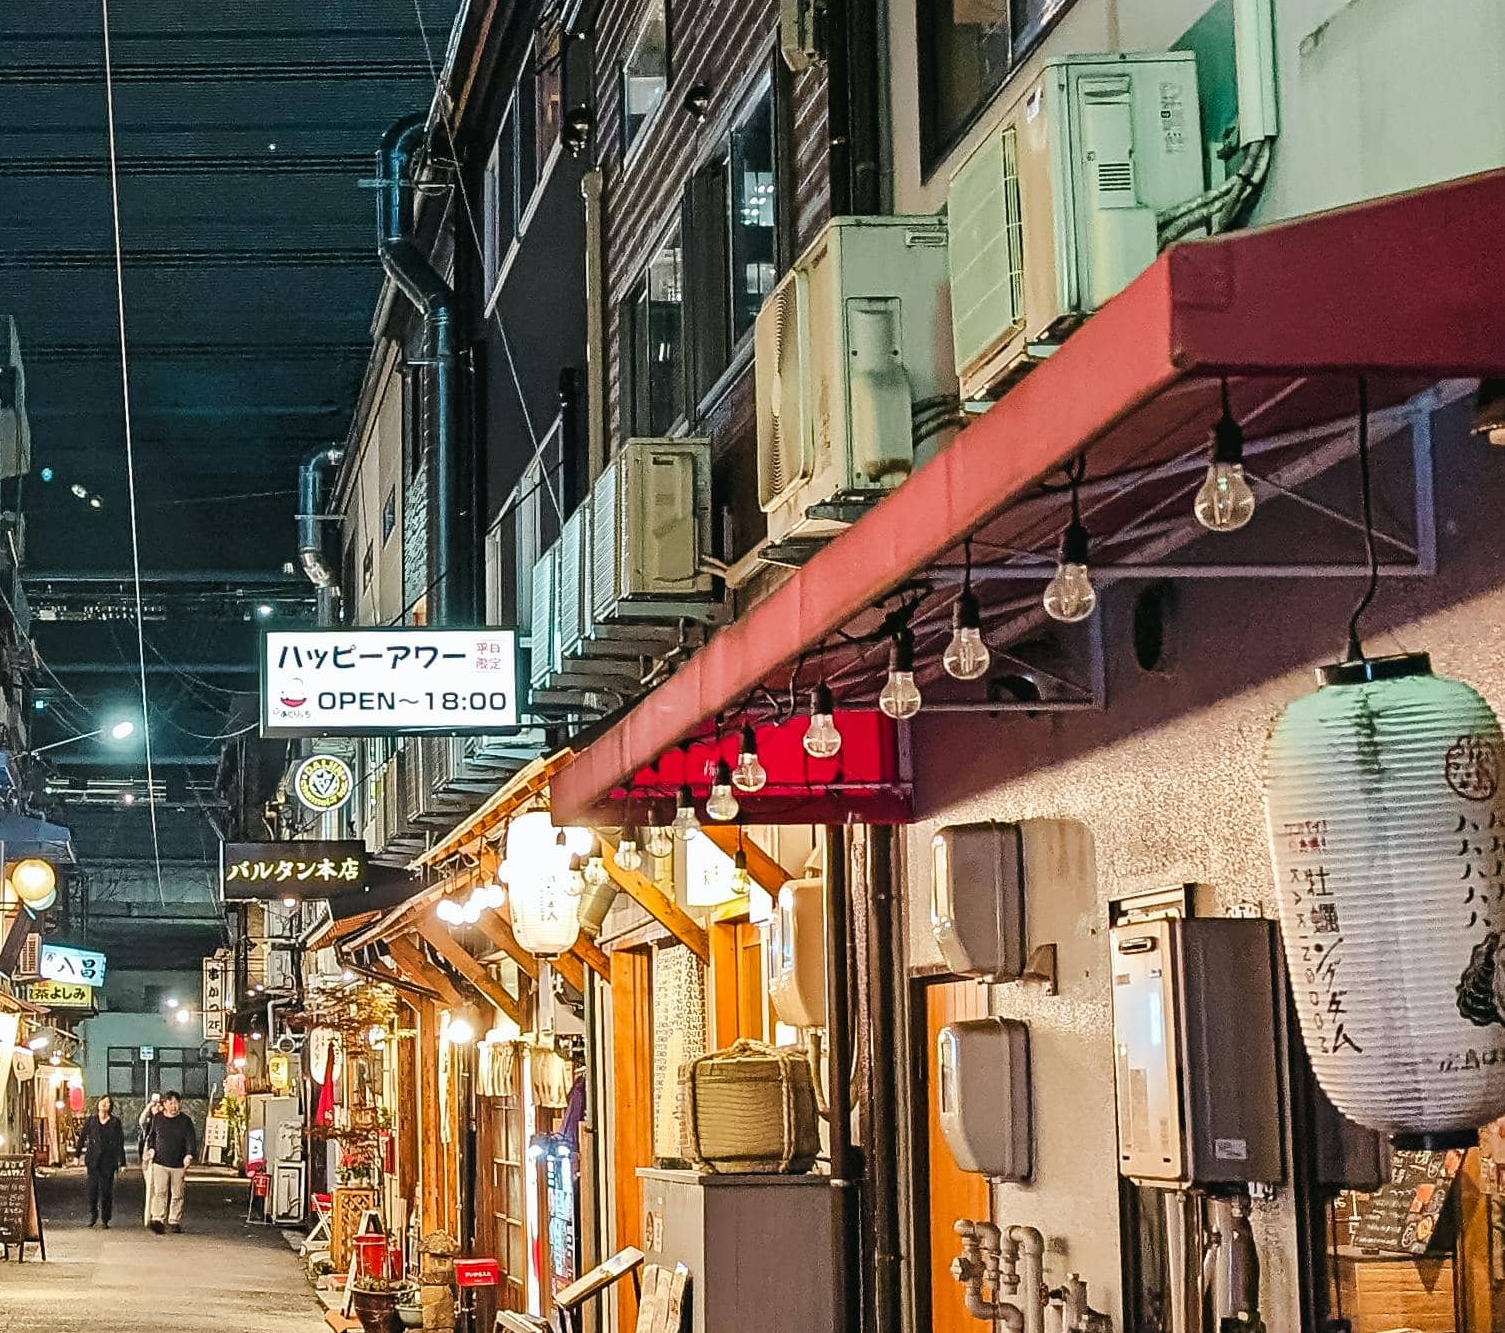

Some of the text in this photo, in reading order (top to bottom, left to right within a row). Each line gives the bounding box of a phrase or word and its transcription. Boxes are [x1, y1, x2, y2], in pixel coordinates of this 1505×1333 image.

[278, 645, 467, 670] ハッピーアワー
[226, 857, 360, 882] バルタン本店
[30, 987, 86, 1000] 茶よしみ
[208, 1020, 221, 1030] 2F
